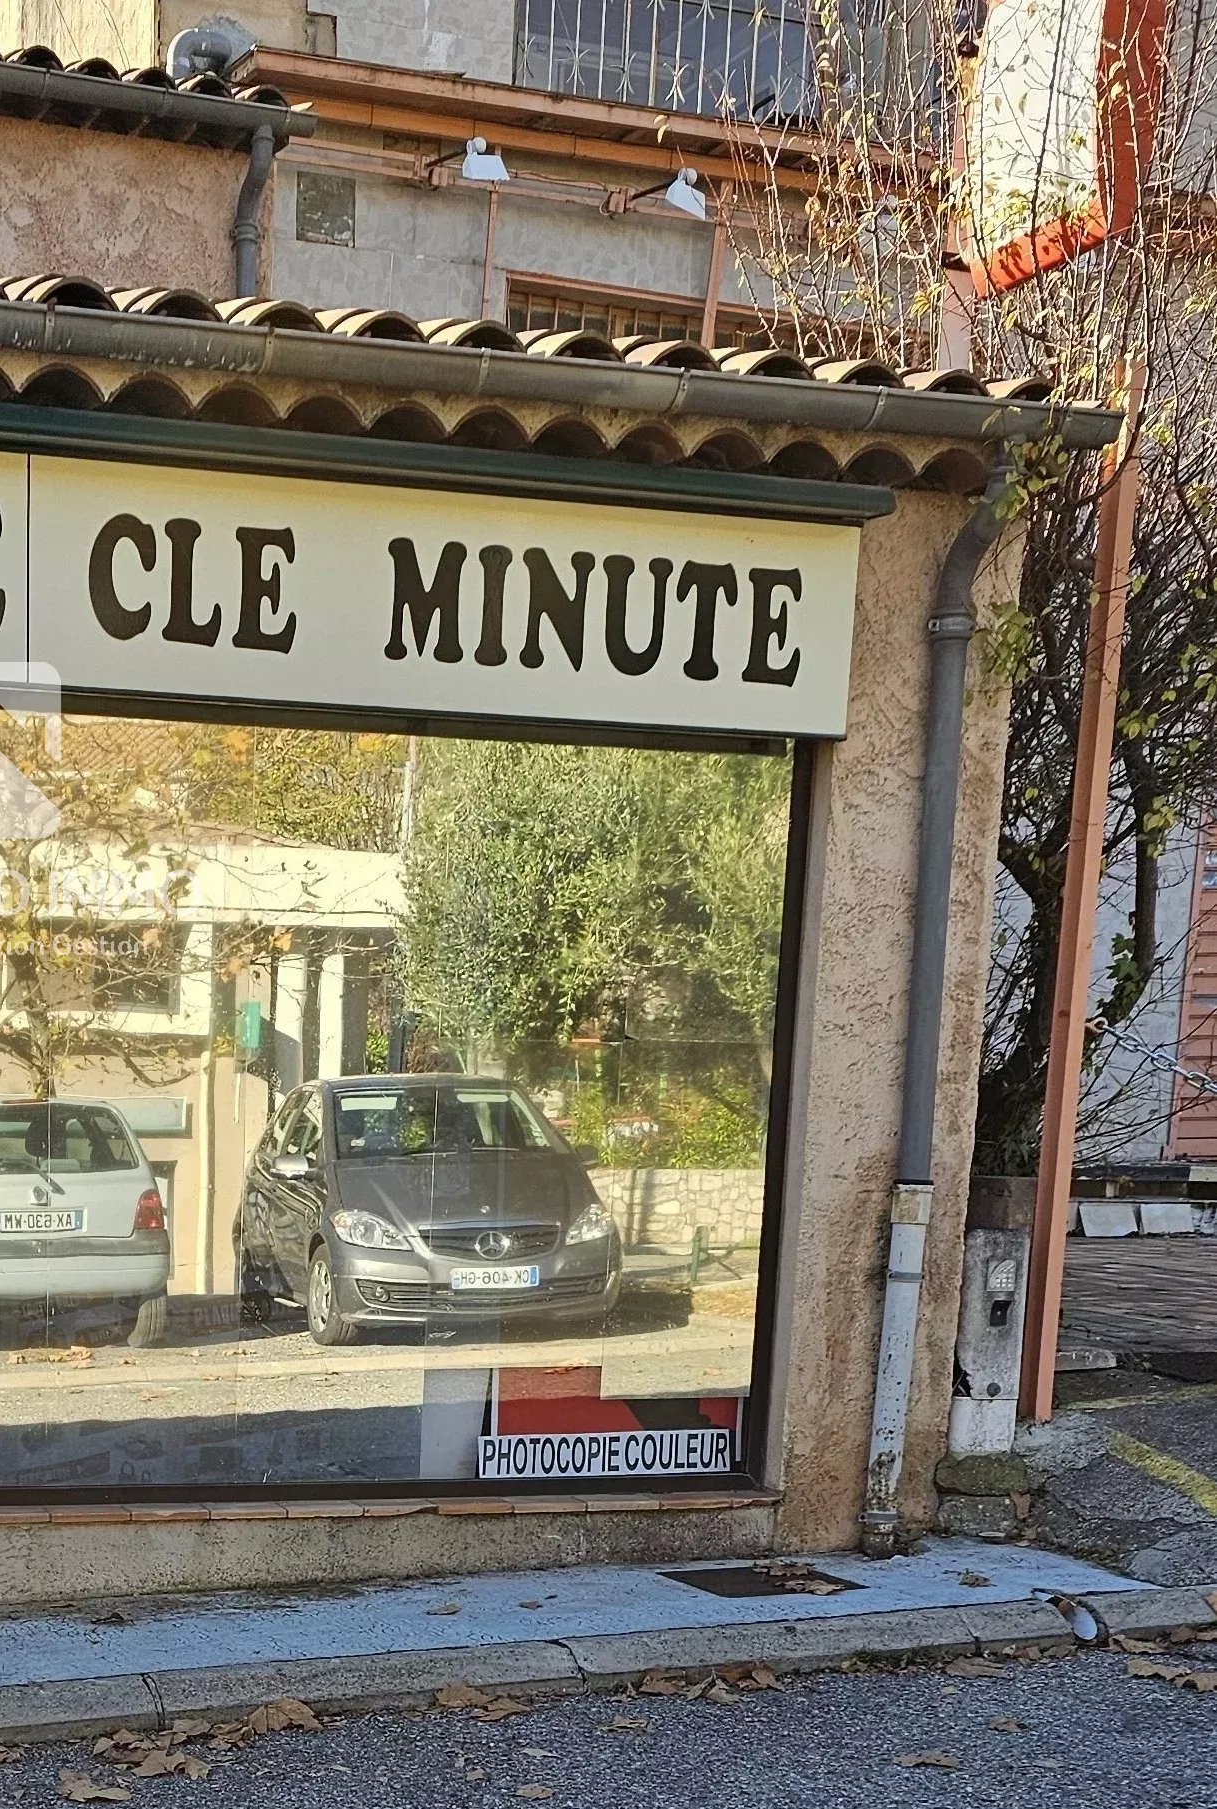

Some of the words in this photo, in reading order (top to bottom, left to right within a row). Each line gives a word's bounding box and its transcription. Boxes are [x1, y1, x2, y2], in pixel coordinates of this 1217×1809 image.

[89, 513, 296, 654] CLE
[384, 537, 802, 687] MINUTE
[482, 1436, 621, 1476] PHOTOCOPIE
[624, 1432, 728, 1472] COULEUR
